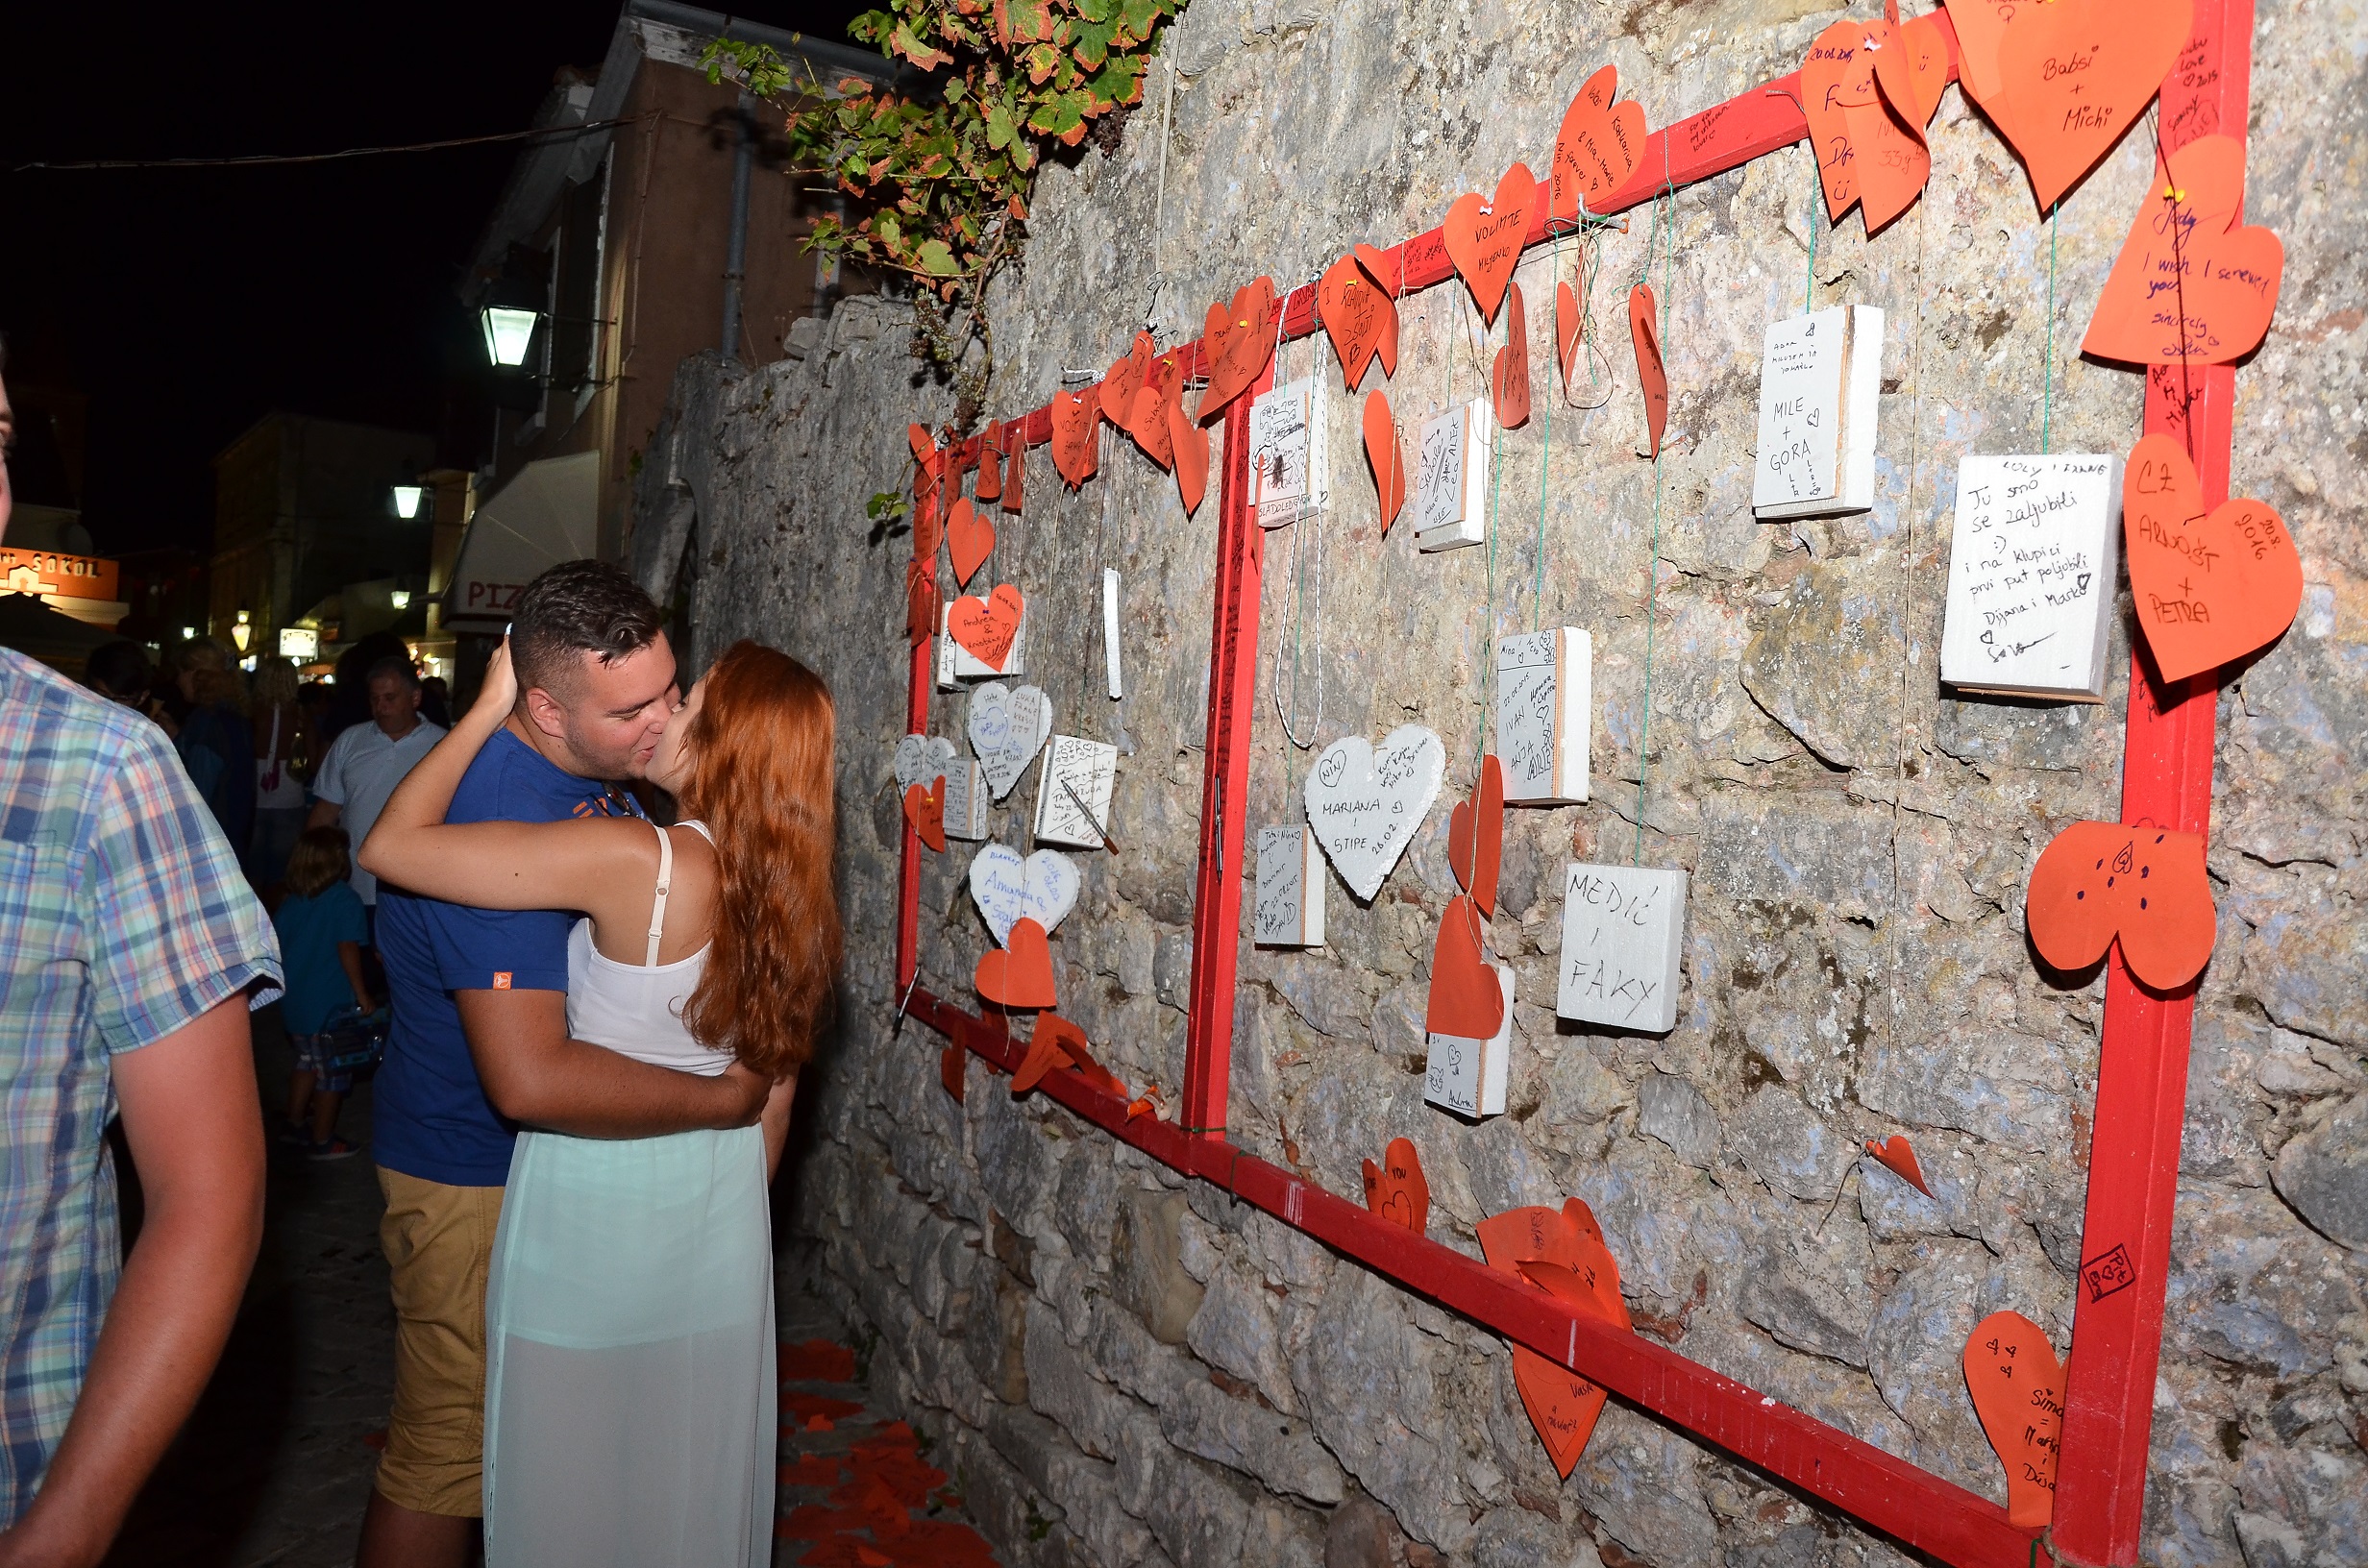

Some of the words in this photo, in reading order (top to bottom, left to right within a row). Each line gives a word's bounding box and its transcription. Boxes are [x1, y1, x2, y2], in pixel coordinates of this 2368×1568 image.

[2042, 44, 2100, 81] Babsi
[2062, 106, 2113, 133] Michi
[1773, 396, 1805, 424] MILE
[1769, 438, 1812, 476] GORA
[1972, 514, 1993, 534] se
[33, 553, 100, 578] SOKOL
[963, 616, 999, 627] Andrea
[2148, 593, 2210, 624] PETRA
[1016, 692, 1036, 706] LUKA
[1505, 704, 1526, 737] IVAN
[1322, 798, 1381, 815] MARIANA
[1334, 837, 1368, 853] STIPE
[1569, 873, 1660, 926] MEDIĆ
[1570, 959, 1657, 1021] FAKY
